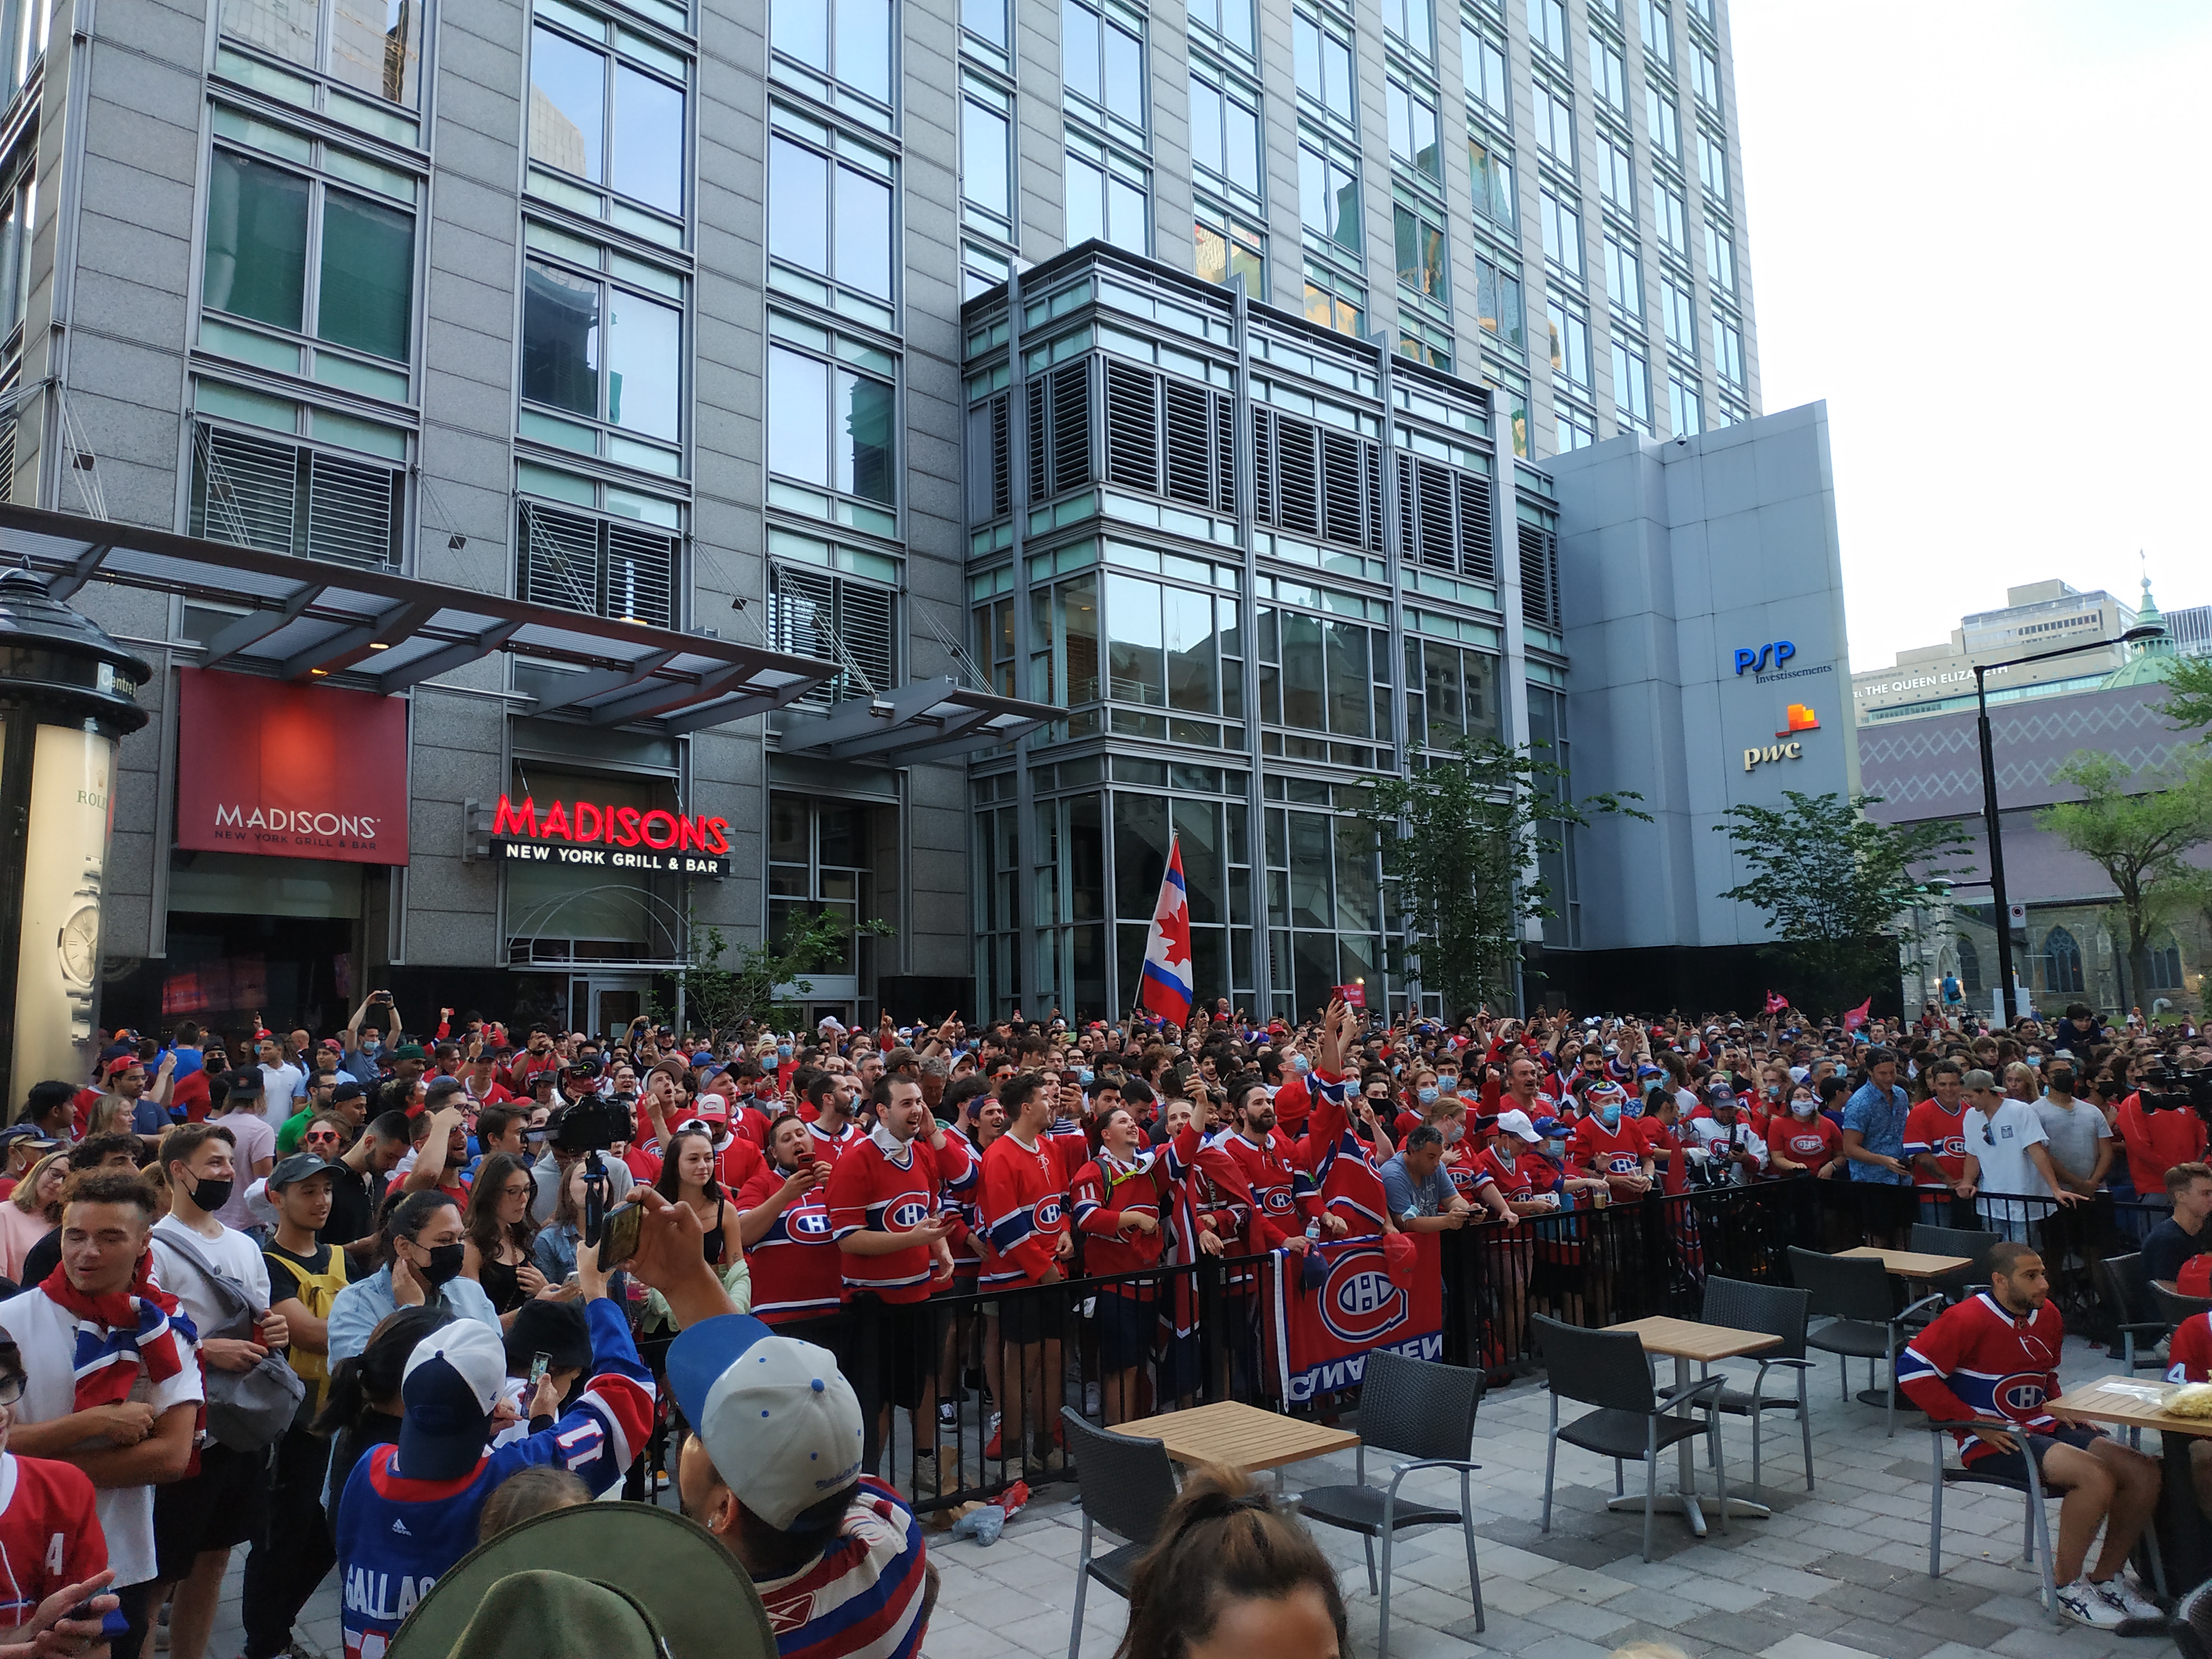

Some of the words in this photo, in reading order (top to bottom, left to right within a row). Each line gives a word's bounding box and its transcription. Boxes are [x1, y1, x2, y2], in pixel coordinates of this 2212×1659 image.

[1735, 640, 1795, 674] PSP
[101, 669, 132, 695] Centre
[1756, 665, 1832, 684] Investissements
[1865, 684, 1888, 696] THE
[1892, 675, 1937, 691] QUEEN
[1940, 665, 2008, 684] ELIZAETH
[1743, 742, 1801, 771] pwc
[215, 804, 376, 838] MADISONS
[493, 794, 729, 854] MADISONS
[215, 831, 246, 840] NEW
[254, 833, 288, 843] YORK
[295, 837, 332, 847] GRILL
[352, 841, 376, 850] BAR
[507, 844, 550, 860] NEW
[558, 848, 605, 864] YORK
[613, 853, 661, 869] GRILL
[669, 858, 679, 870] &
[686, 859, 718, 873] BAR
[1283, 1159, 1293, 1172] C
[1079, 1182, 1097, 1199] 11
[2167, 1363, 2187, 1385] 4
[556, 1418, 604, 1472] 11
[44, 1533, 64, 1575] A
